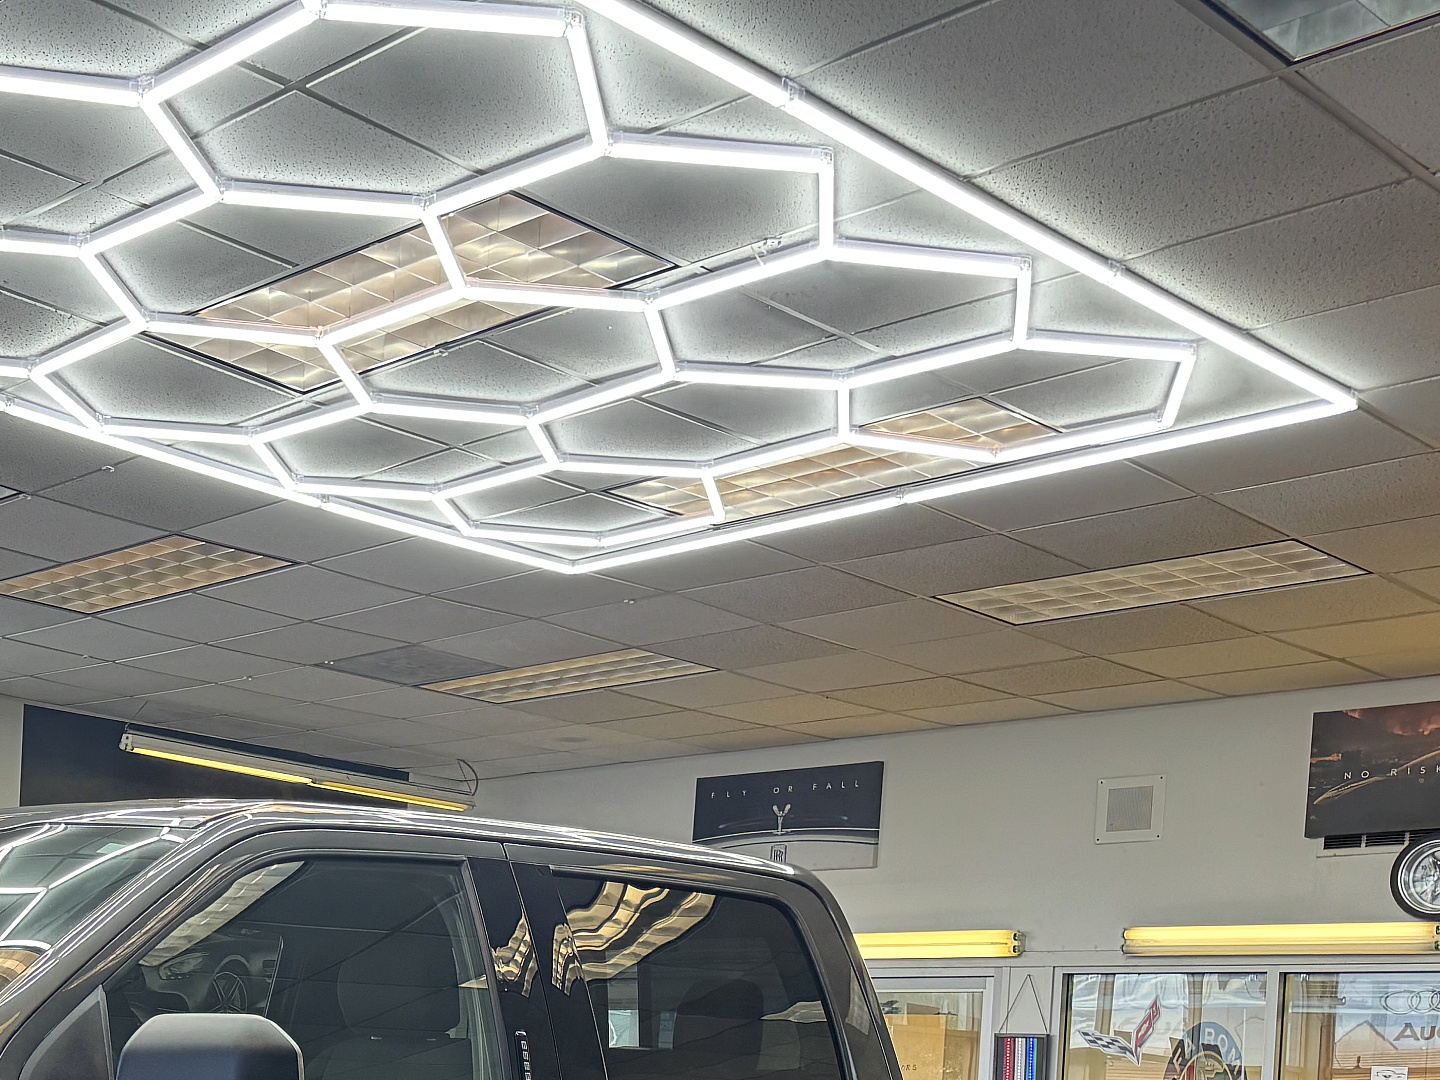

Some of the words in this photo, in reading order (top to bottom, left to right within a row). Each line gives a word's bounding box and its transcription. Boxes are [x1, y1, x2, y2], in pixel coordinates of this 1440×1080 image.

[1344, 770, 1370, 780] NO
[711, 789, 747, 799] FLY
[773, 785, 794, 794] OR
[812, 780, 860, 791] FALL
